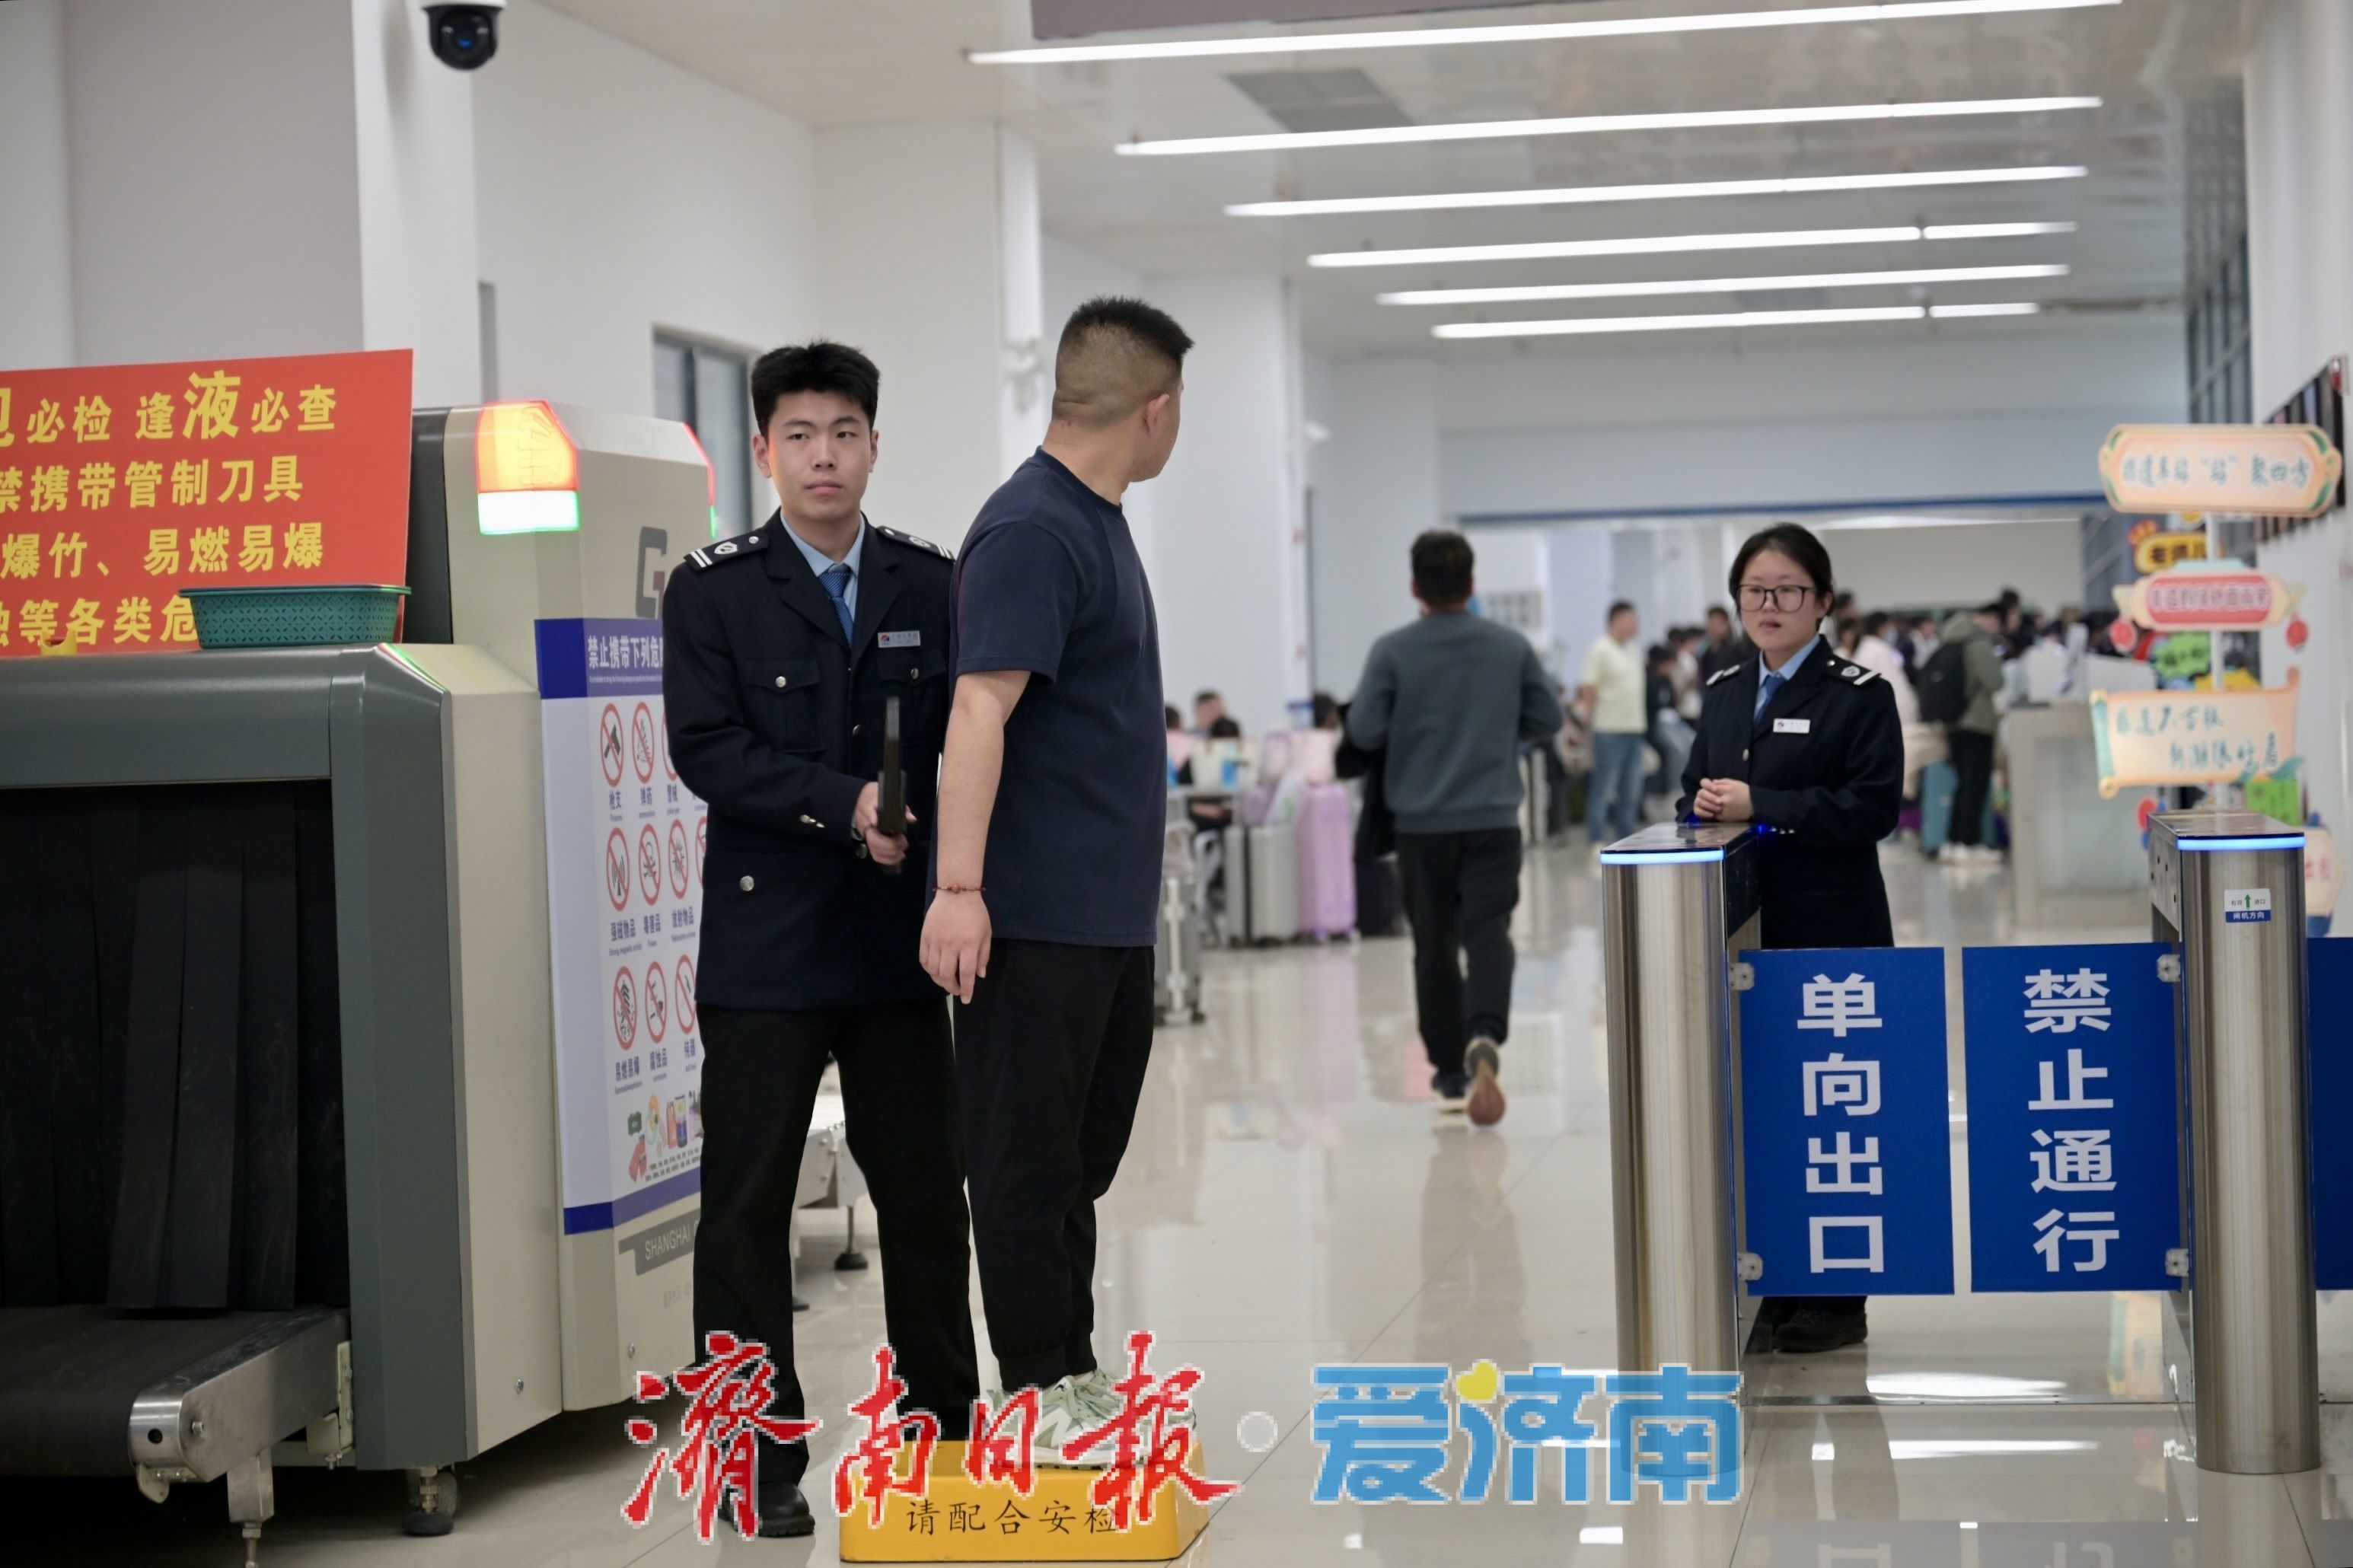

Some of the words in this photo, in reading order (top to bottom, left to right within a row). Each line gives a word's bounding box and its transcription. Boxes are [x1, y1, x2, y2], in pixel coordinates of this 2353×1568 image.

[0, 387, 112, 448] 必检
[135, 370, 336, 439] 逢液必查
[0, 455, 303, 515] 禁携带管制刀具
[0, 522, 324, 580] 爆竹、易燃易爆
[0, 594, 198, 647] 等各类危
[1797, 973, 1884, 1273] 单向出口
[2023, 967, 2119, 1273] 禁止通行
[645, 1223, 690, 1260] SHANGHAI
[906, 1499, 1121, 1536] 请配合安检
